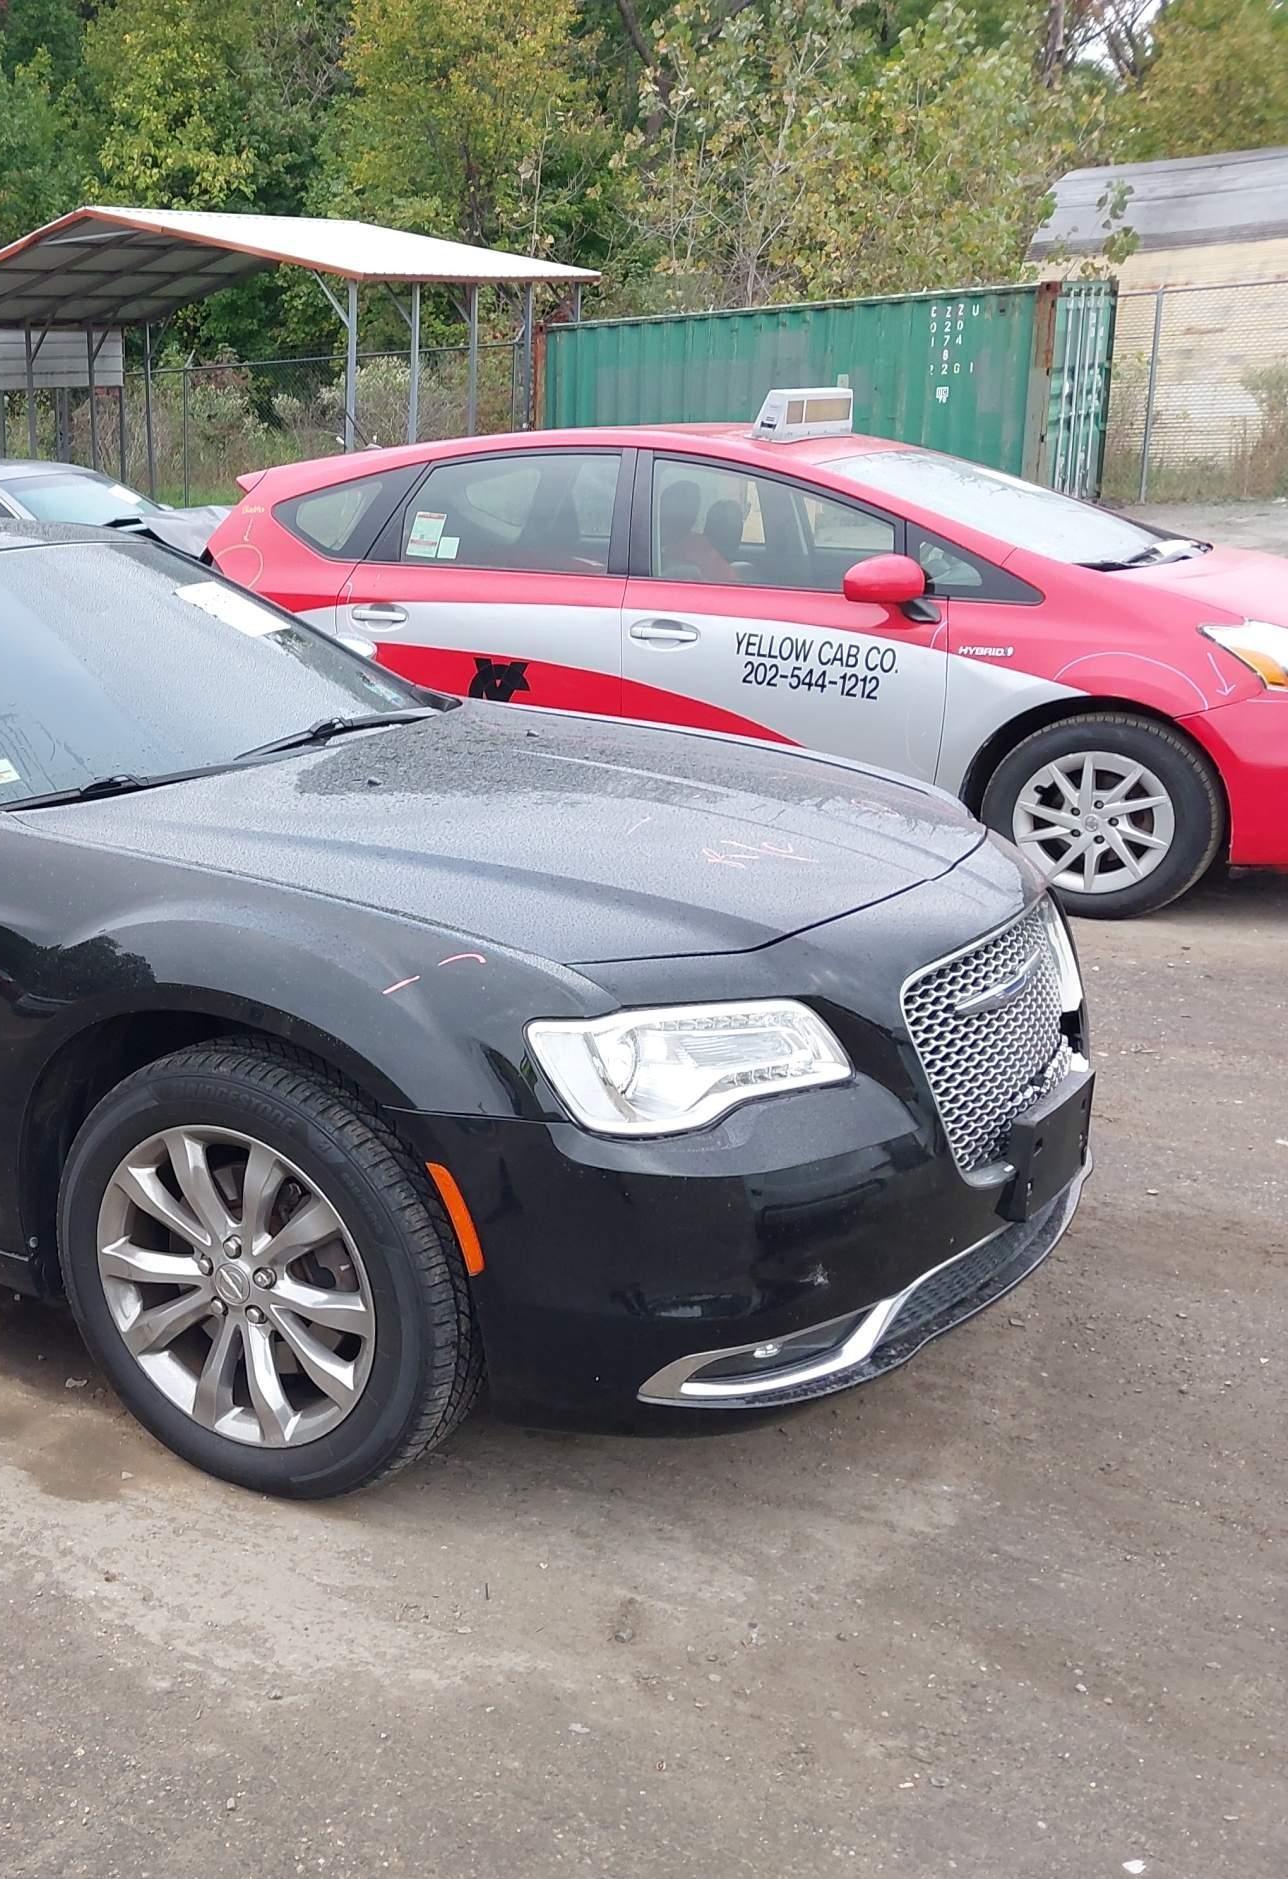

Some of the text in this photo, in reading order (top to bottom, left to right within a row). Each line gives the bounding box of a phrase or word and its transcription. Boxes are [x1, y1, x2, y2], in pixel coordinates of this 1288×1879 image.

[931, 304, 980, 318] CZZU
[930, 320, 964, 333] 020
[735, 632, 899, 674] YELLOW CAB CO.
[958, 645, 1005, 657] HYBRID
[741, 660, 880, 700] 202-544-1212
